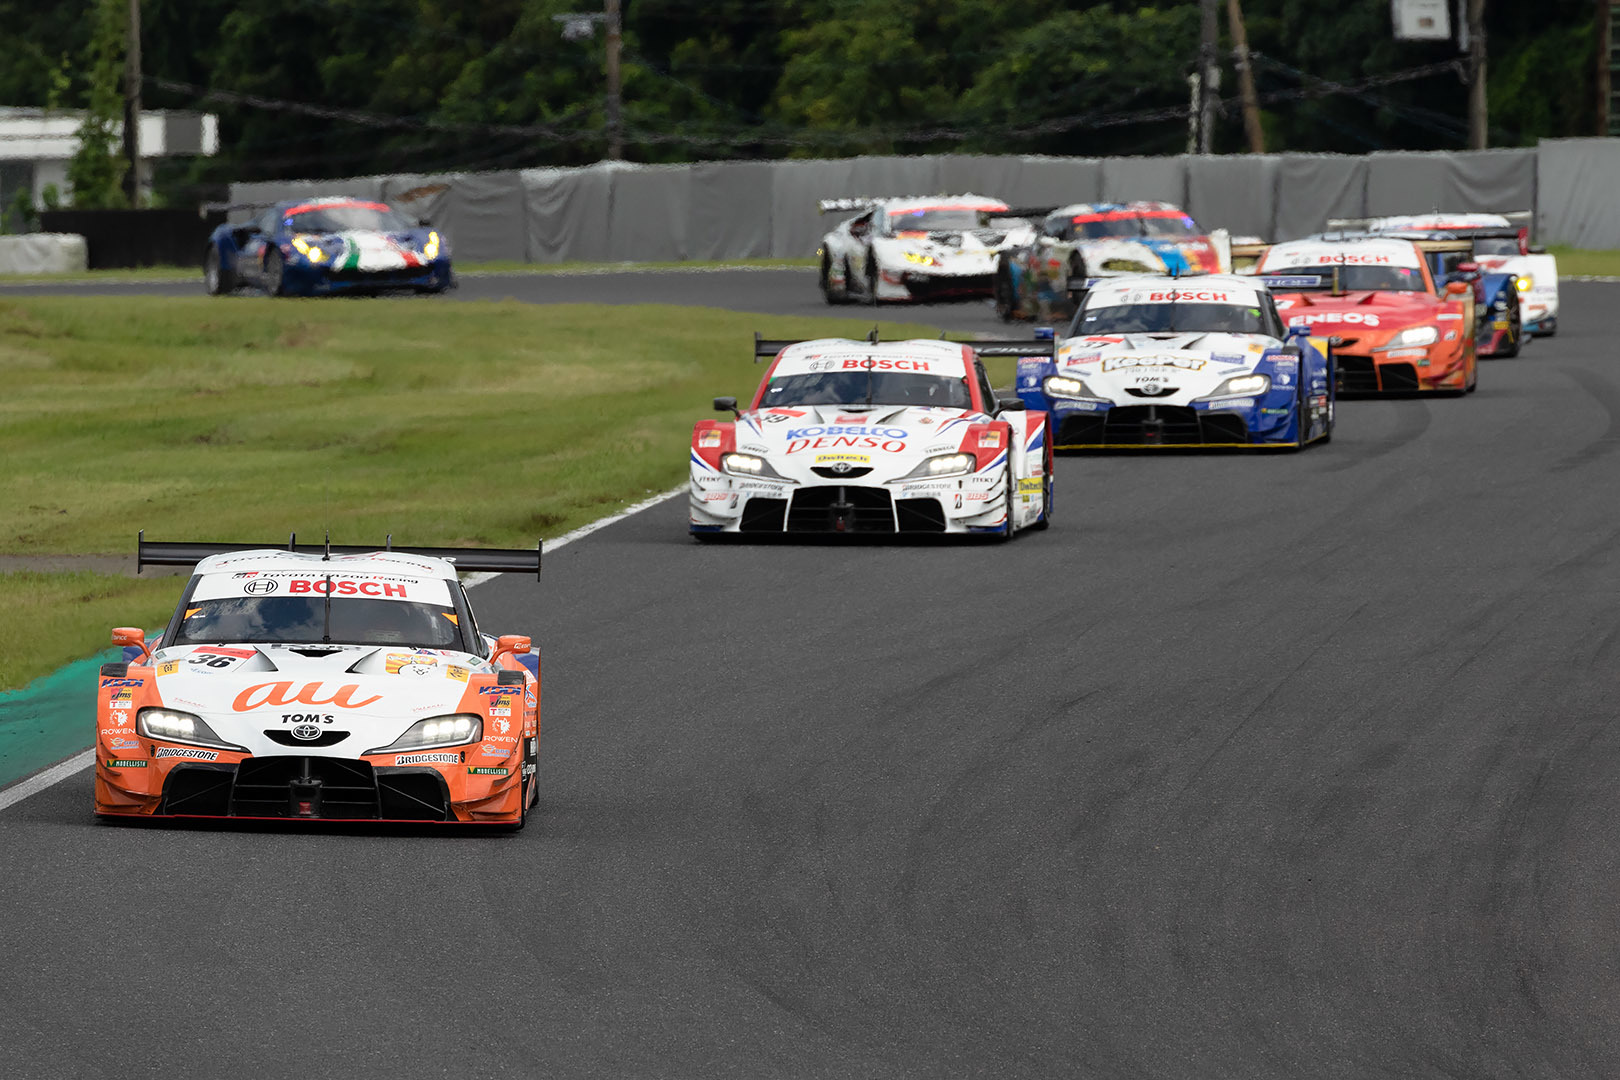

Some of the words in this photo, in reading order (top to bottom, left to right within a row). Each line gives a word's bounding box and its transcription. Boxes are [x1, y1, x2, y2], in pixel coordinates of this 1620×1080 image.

[1318, 255, 1389, 264] BOSCH
[1150, 292, 1228, 302] BOSCH
[1289, 312, 1380, 327] ENEOS
[842, 359, 930, 372] BOSCH
[786, 426, 908, 441] KOBELCO
[785, 436, 906, 455] DENSO
[289, 579, 407, 598] BOSCH
[188, 654, 236, 668] 36
[101, 678, 144, 688] KDDI
[232, 681, 384, 712] au
[479, 686, 521, 695] KDDI
[101, 728, 136, 736] ROWEN
[483, 735, 518, 744] ROWEN
[157, 748, 218, 760] BRIDGESTONE
[397, 754, 459, 765] BRIDGESTONE
